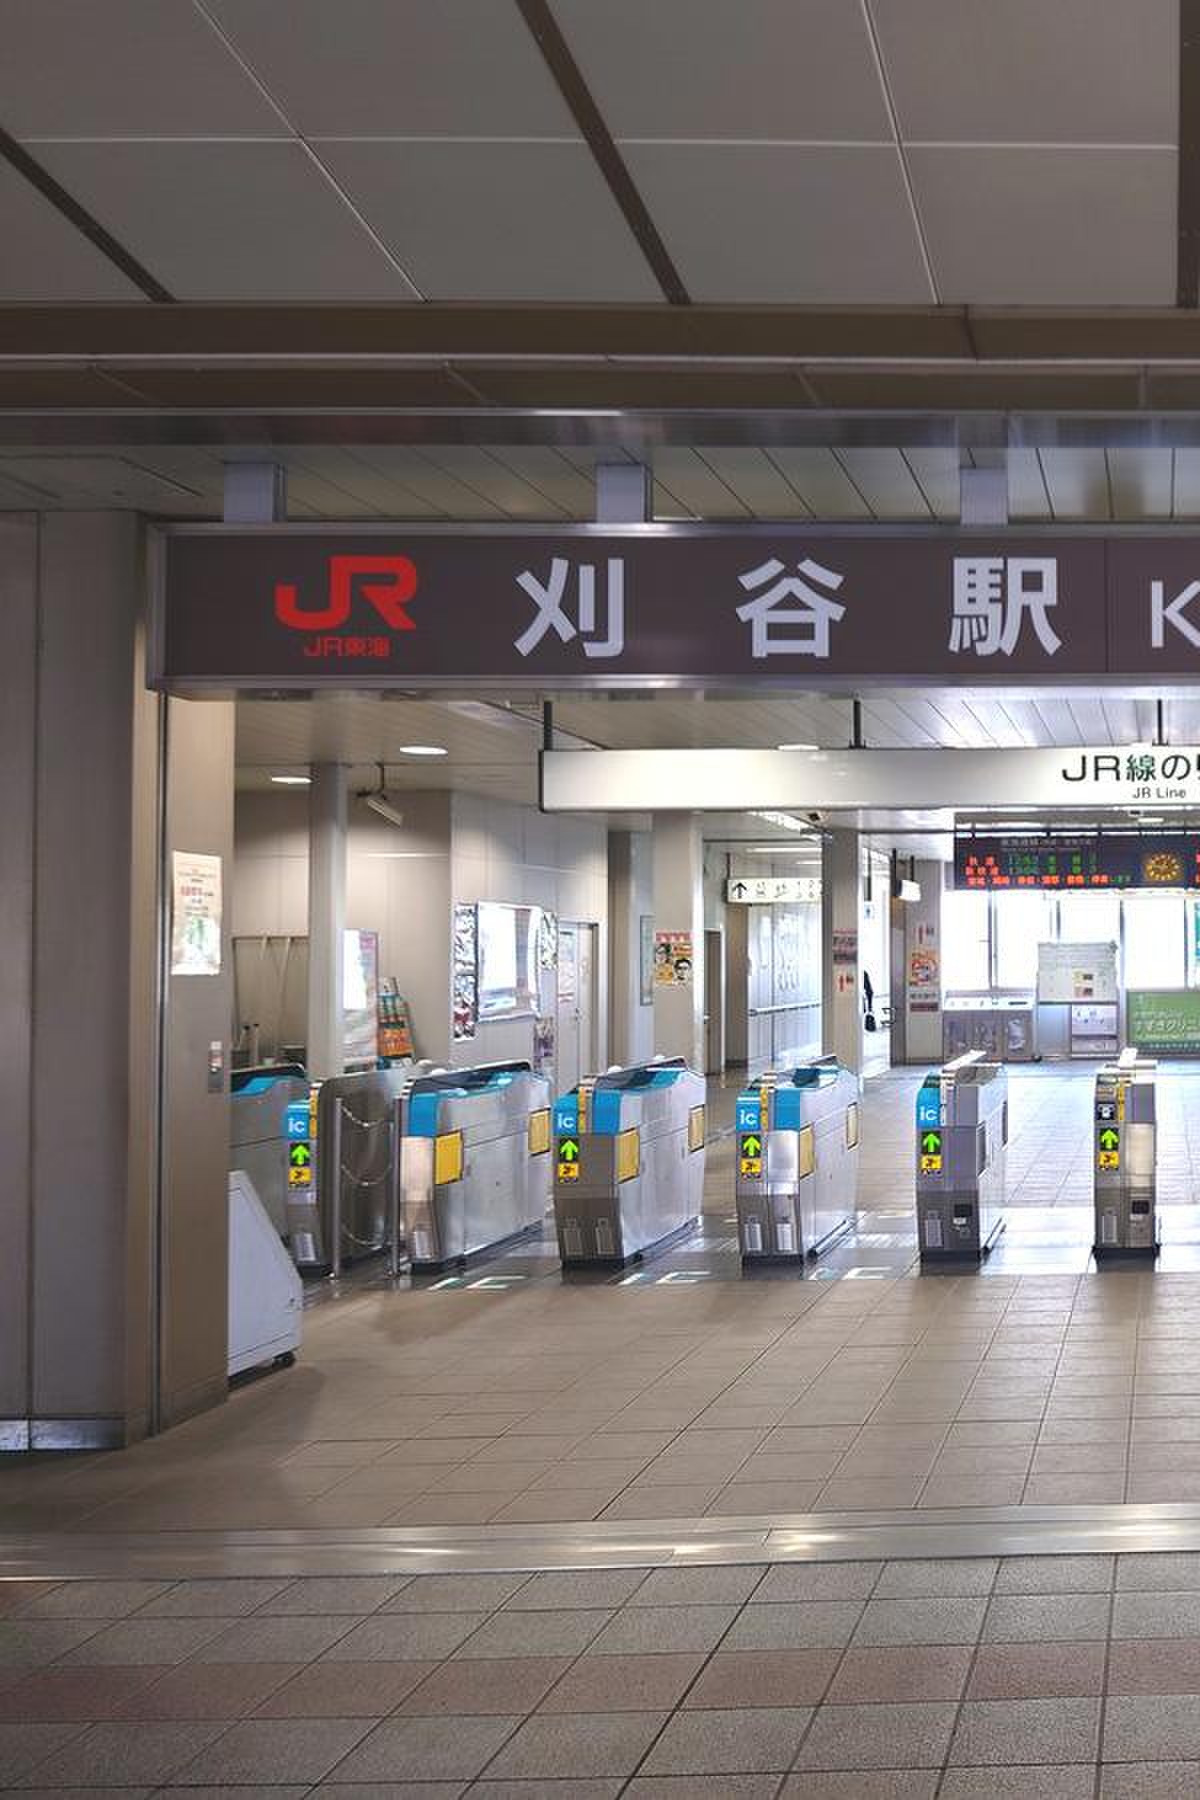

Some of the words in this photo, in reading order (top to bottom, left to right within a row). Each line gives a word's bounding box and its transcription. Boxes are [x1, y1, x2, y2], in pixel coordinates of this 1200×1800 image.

[275, 556, 417, 630] JR
[513, 557, 1062, 657] 刈谷駅
[303, 636, 391, 657] JR東海
[1132, 786, 1151, 799] JR
[1156, 786, 1187, 799] Line
